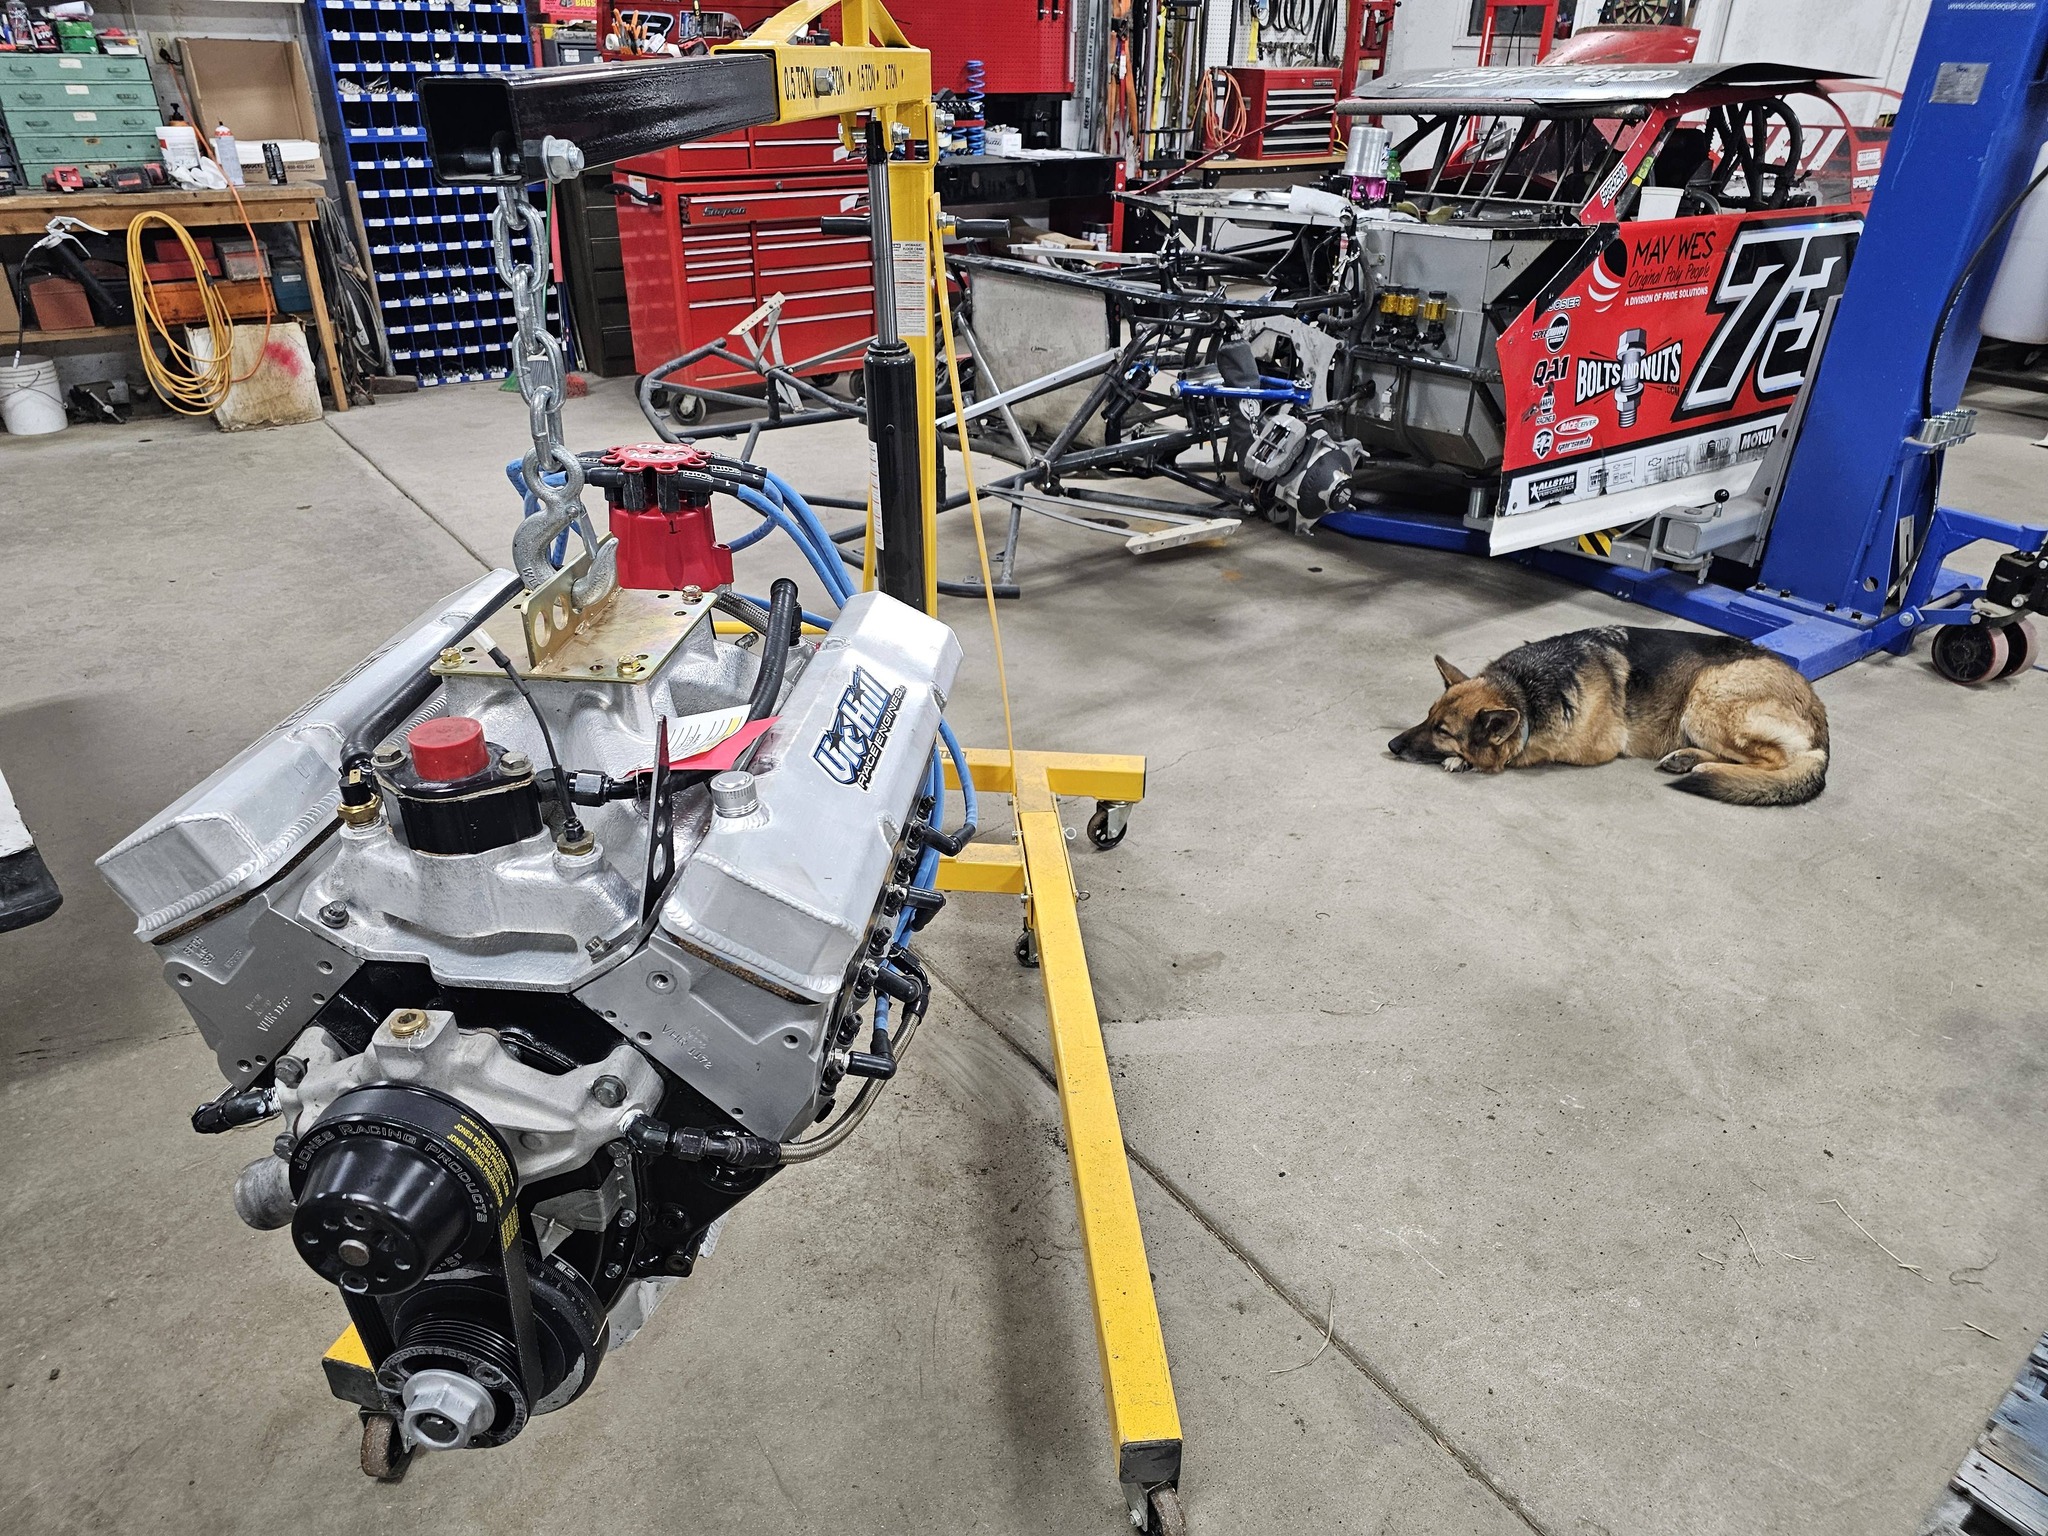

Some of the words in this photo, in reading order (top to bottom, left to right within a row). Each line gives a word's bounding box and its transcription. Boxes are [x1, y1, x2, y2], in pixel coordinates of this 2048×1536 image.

[784, 66, 796, 101] 0.5
[796, 65, 812, 99] TON
[857, 63, 865, 92] 1.5
[865, 63, 876, 91] TON
[888, 63, 898, 90] TON
[1632, 234, 1676, 267] MAY
[1677, 231, 1717, 261] WES
[1628, 267, 1662, 290] Original
[1664, 262, 1683, 284] Poly
[1686, 261, 1710, 283] People
[1624, 297, 1630, 307] A
[1629, 293, 1653, 306] DIVISION
[1653, 292, 1662, 301] OF
[1662, 290, 1679, 301] PRIDE
[1679, 286, 1709, 298] SOLUTIONS
[1532, 355, 1570, 388] QA1
[1576, 360, 1621, 403] BOLTS
[1621, 362, 1640, 382] AND
[1640, 342, 1682, 383] NUTS
[1741, 427, 1776, 450] MOTUL
[630, 452, 678, 460] MSD
[683, 471, 714, 482] SCOTT
[1539, 474, 1575, 490] ALLSTAR
[669, 520, 681, 534] 1
[858, 743, 880, 791] RACE
[875, 687, 903, 745] ENGINES
[662, 1023, 688, 1047] VHR
[687, 1046, 713, 1070] 1172
[446, 1133, 467, 1151] JONES
[465, 1146, 485, 1168] RACING
[453, 1123, 474, 1140] JONES
[472, 1136, 492, 1158] RACING
[294, 1130, 336, 1171] JONES
[338, 1124, 418, 1145] RACING
[425, 1142, 489, 1223] PRODUCTS
